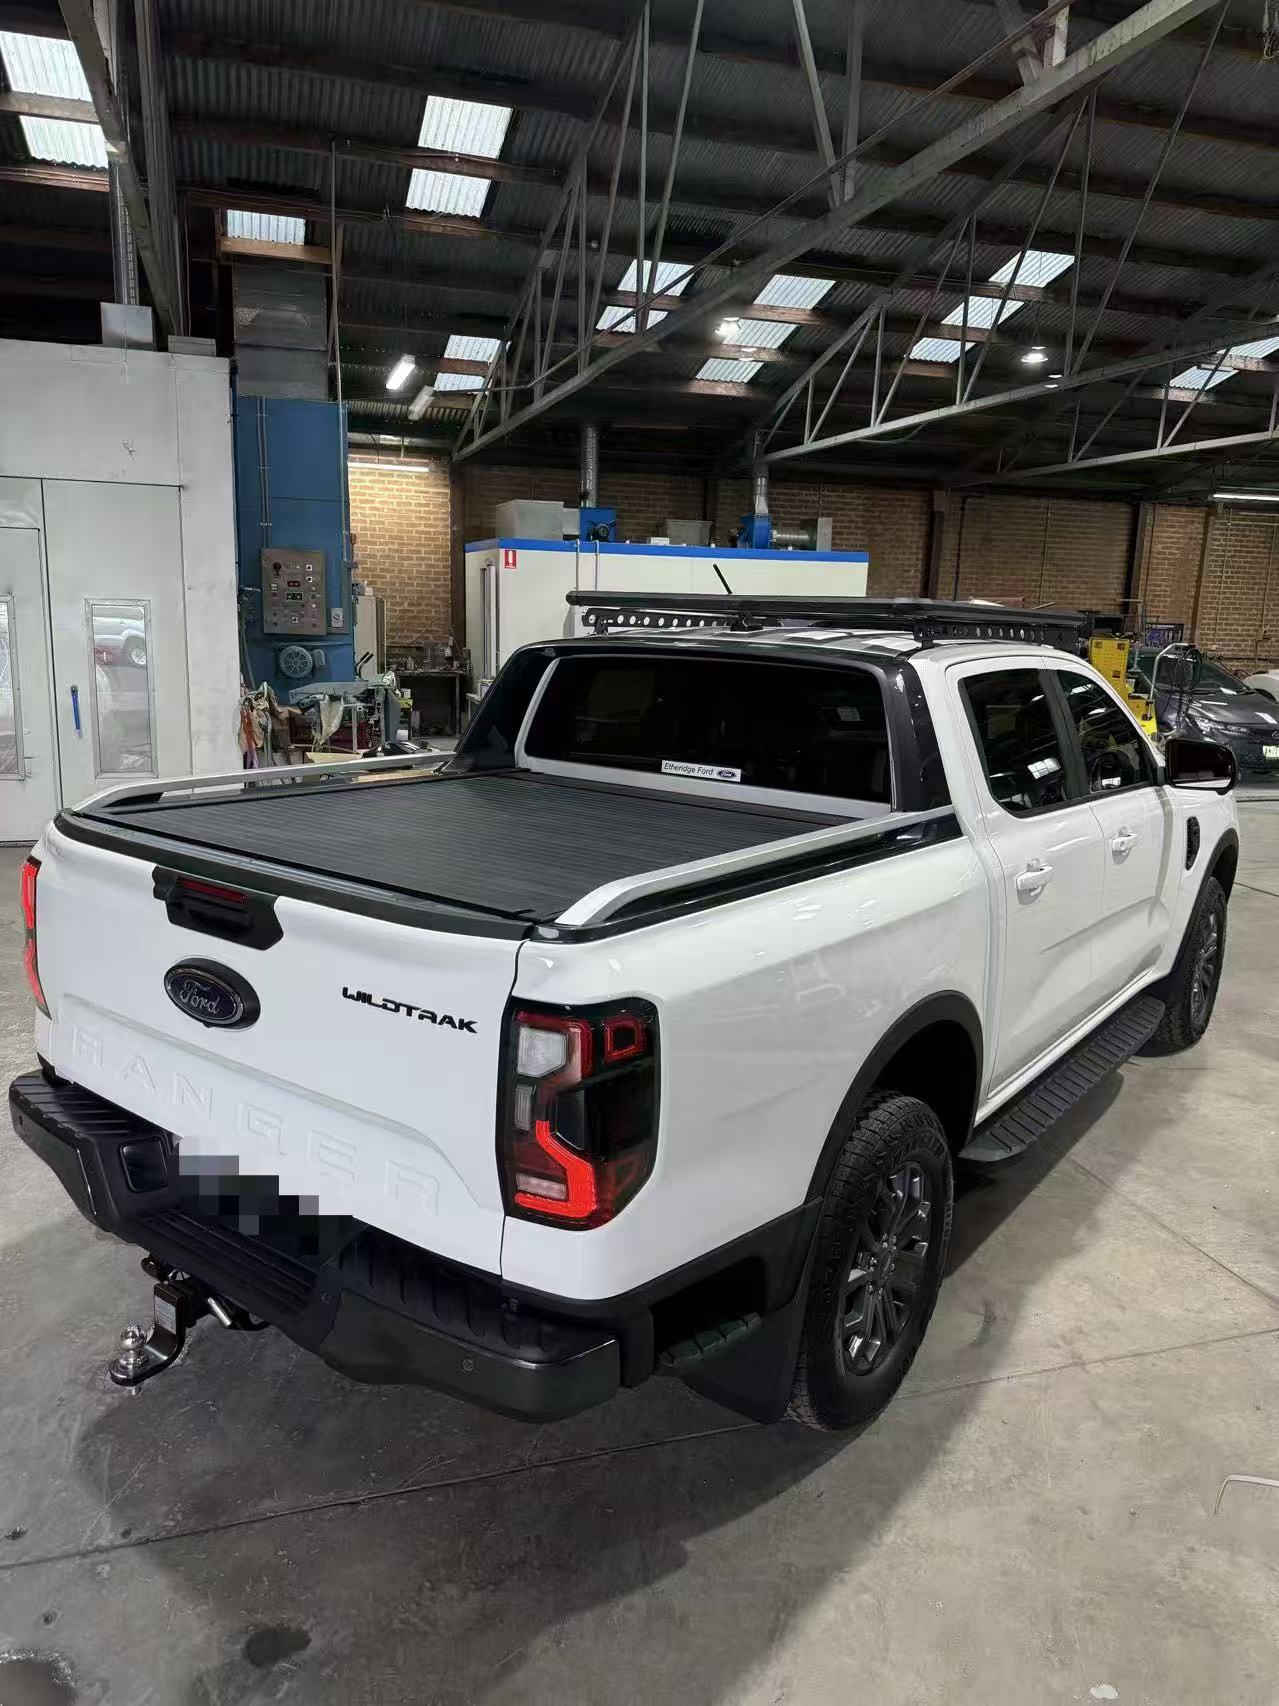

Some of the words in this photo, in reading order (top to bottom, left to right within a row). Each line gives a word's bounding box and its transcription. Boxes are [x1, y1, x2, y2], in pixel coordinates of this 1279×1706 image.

[664, 762, 695, 774] Etheridge
[697, 766, 713, 775] Ford
[180, 979, 221, 1014] Ford
[342, 986, 479, 1034] WILDTRAK
[70, 1022, 440, 1217] RANGER
